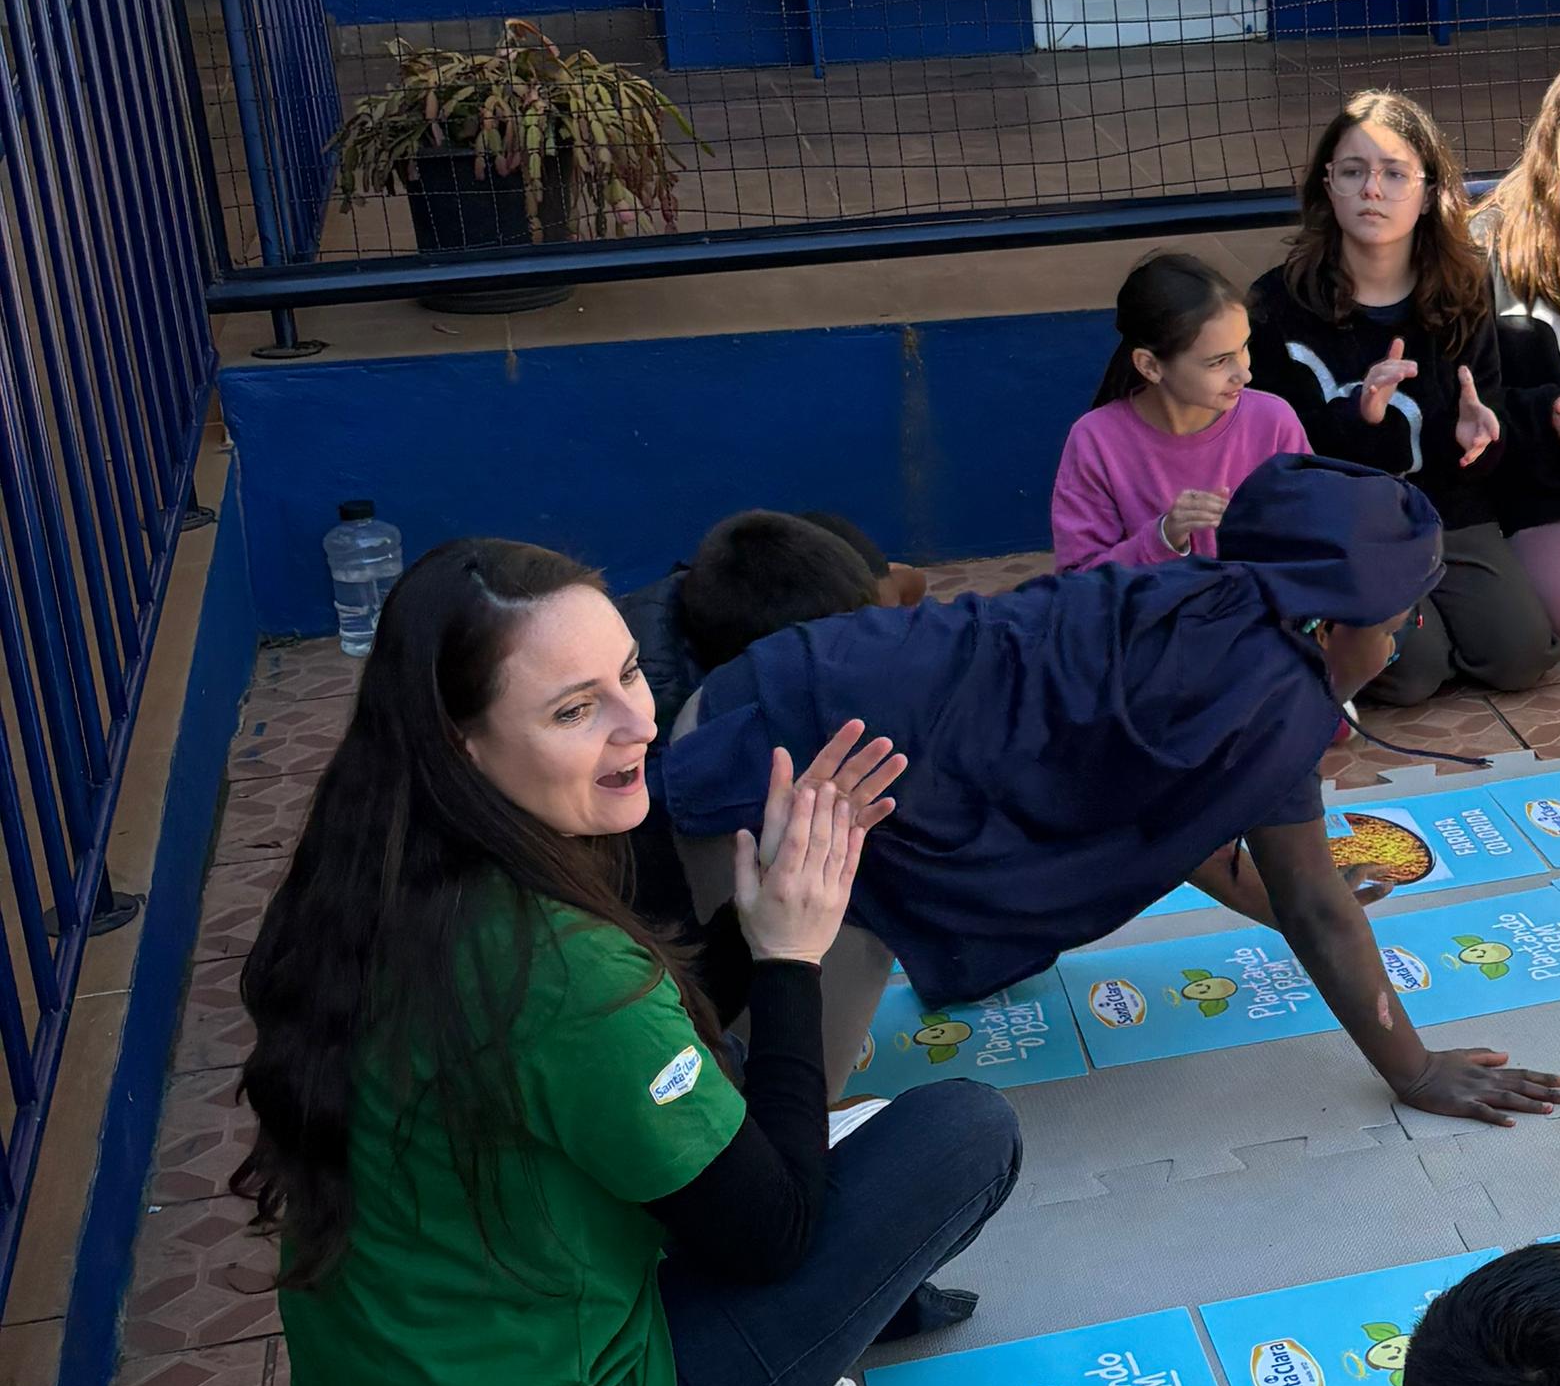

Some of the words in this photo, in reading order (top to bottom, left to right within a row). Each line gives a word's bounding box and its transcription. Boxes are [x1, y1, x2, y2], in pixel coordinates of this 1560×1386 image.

[1434, 817, 1478, 856] FAROFA
[1461, 807, 1513, 856] COLORIDA
[1225, 948, 1287, 1019] Plantando
[655, 1074, 685, 1099] Santa
[1270, 1343, 1295, 1375] Clara
